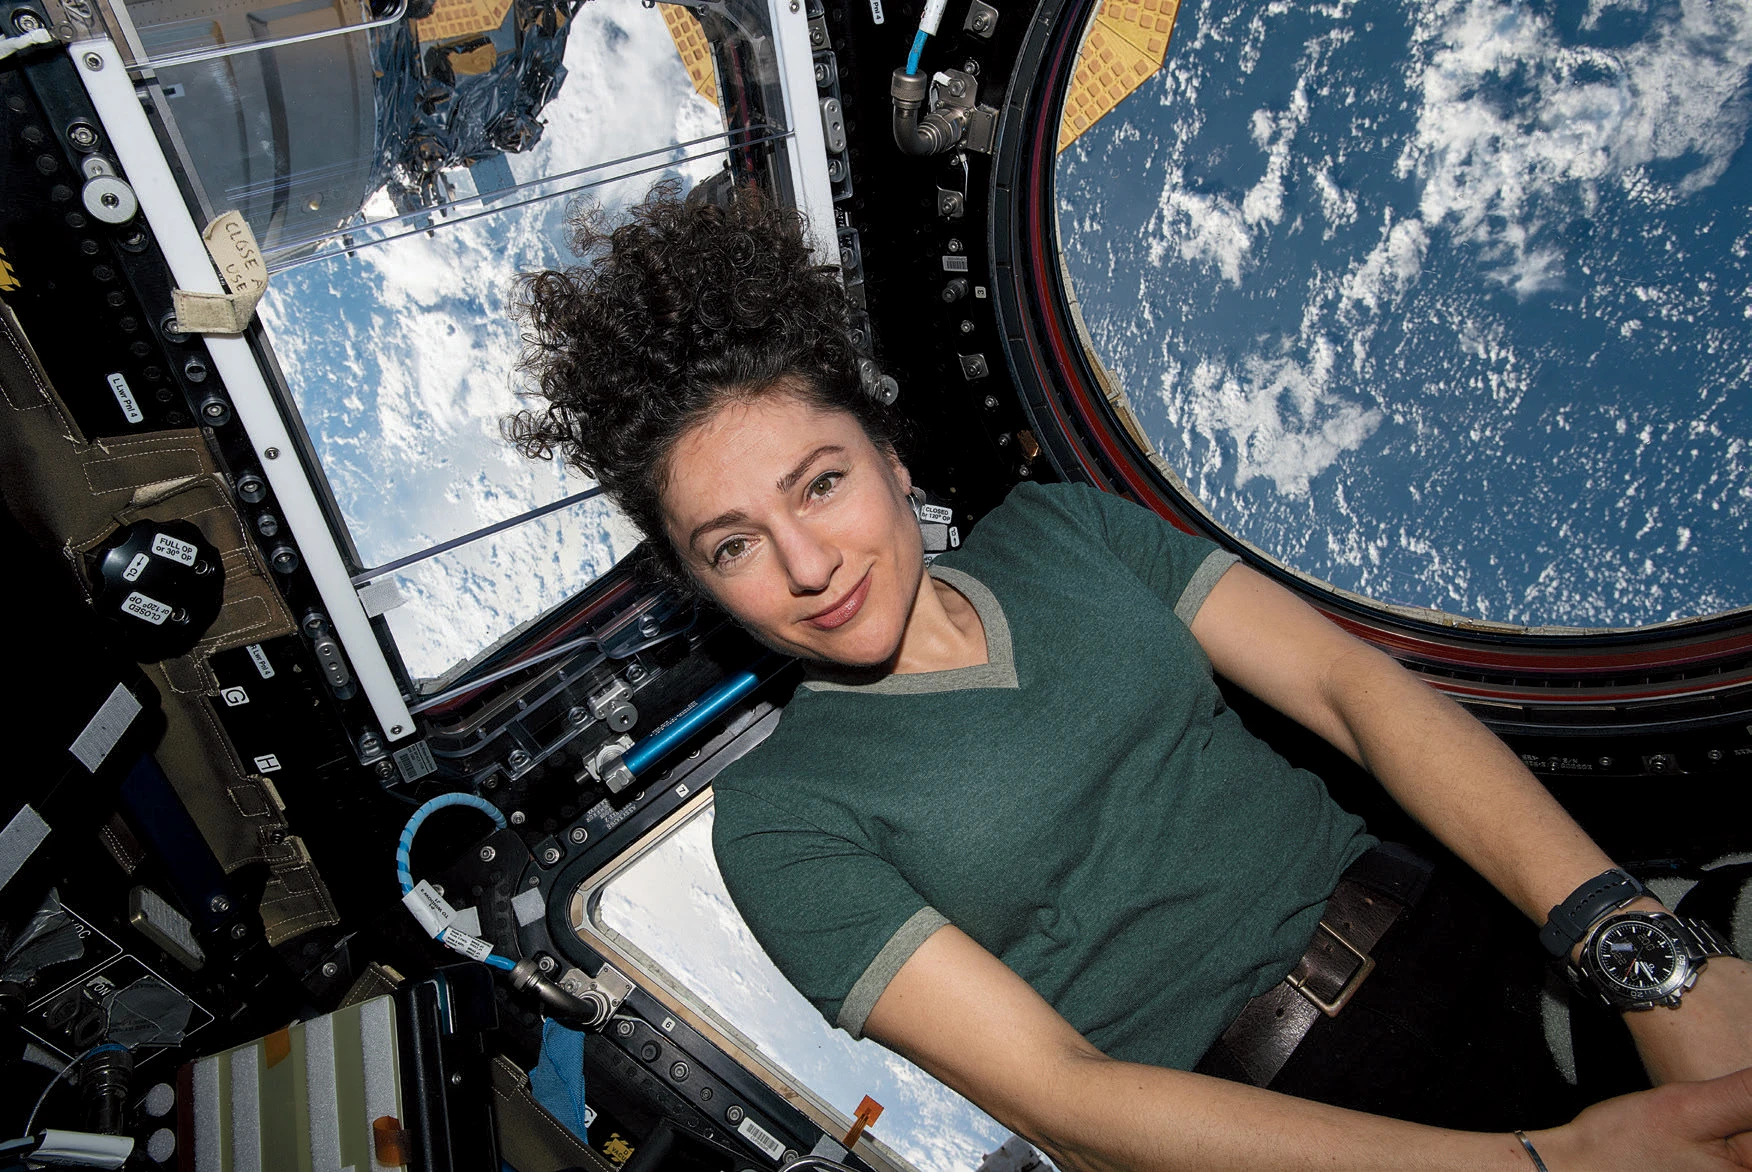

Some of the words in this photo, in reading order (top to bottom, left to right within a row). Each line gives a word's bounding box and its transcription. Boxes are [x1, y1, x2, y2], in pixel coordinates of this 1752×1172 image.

[225, 222, 259, 270] CLOSE
[226, 264, 247, 291] USE
[116, 384, 127, 398] Lwr
[124, 399, 135, 412] Pnl
[925, 506, 949, 516] CLOSED
[159, 537, 180, 550] FULL
[181, 545, 193, 554] OP
[181, 553, 192, 562] OP
[126, 567, 138, 577] CL
[129, 595, 143, 604] OP
[128, 603, 161, 621] CLOSED
[253, 649, 262, 661] Lwr
[259, 661, 269, 671] Pnl
[225, 689, 246, 704] G
[257, 756, 279, 770] H
[424, 892, 443, 913] WINDOW
[441, 911, 449, 919] TO
[93, 983, 112, 996] ON
[612, 1146, 627, 1160] VACU
